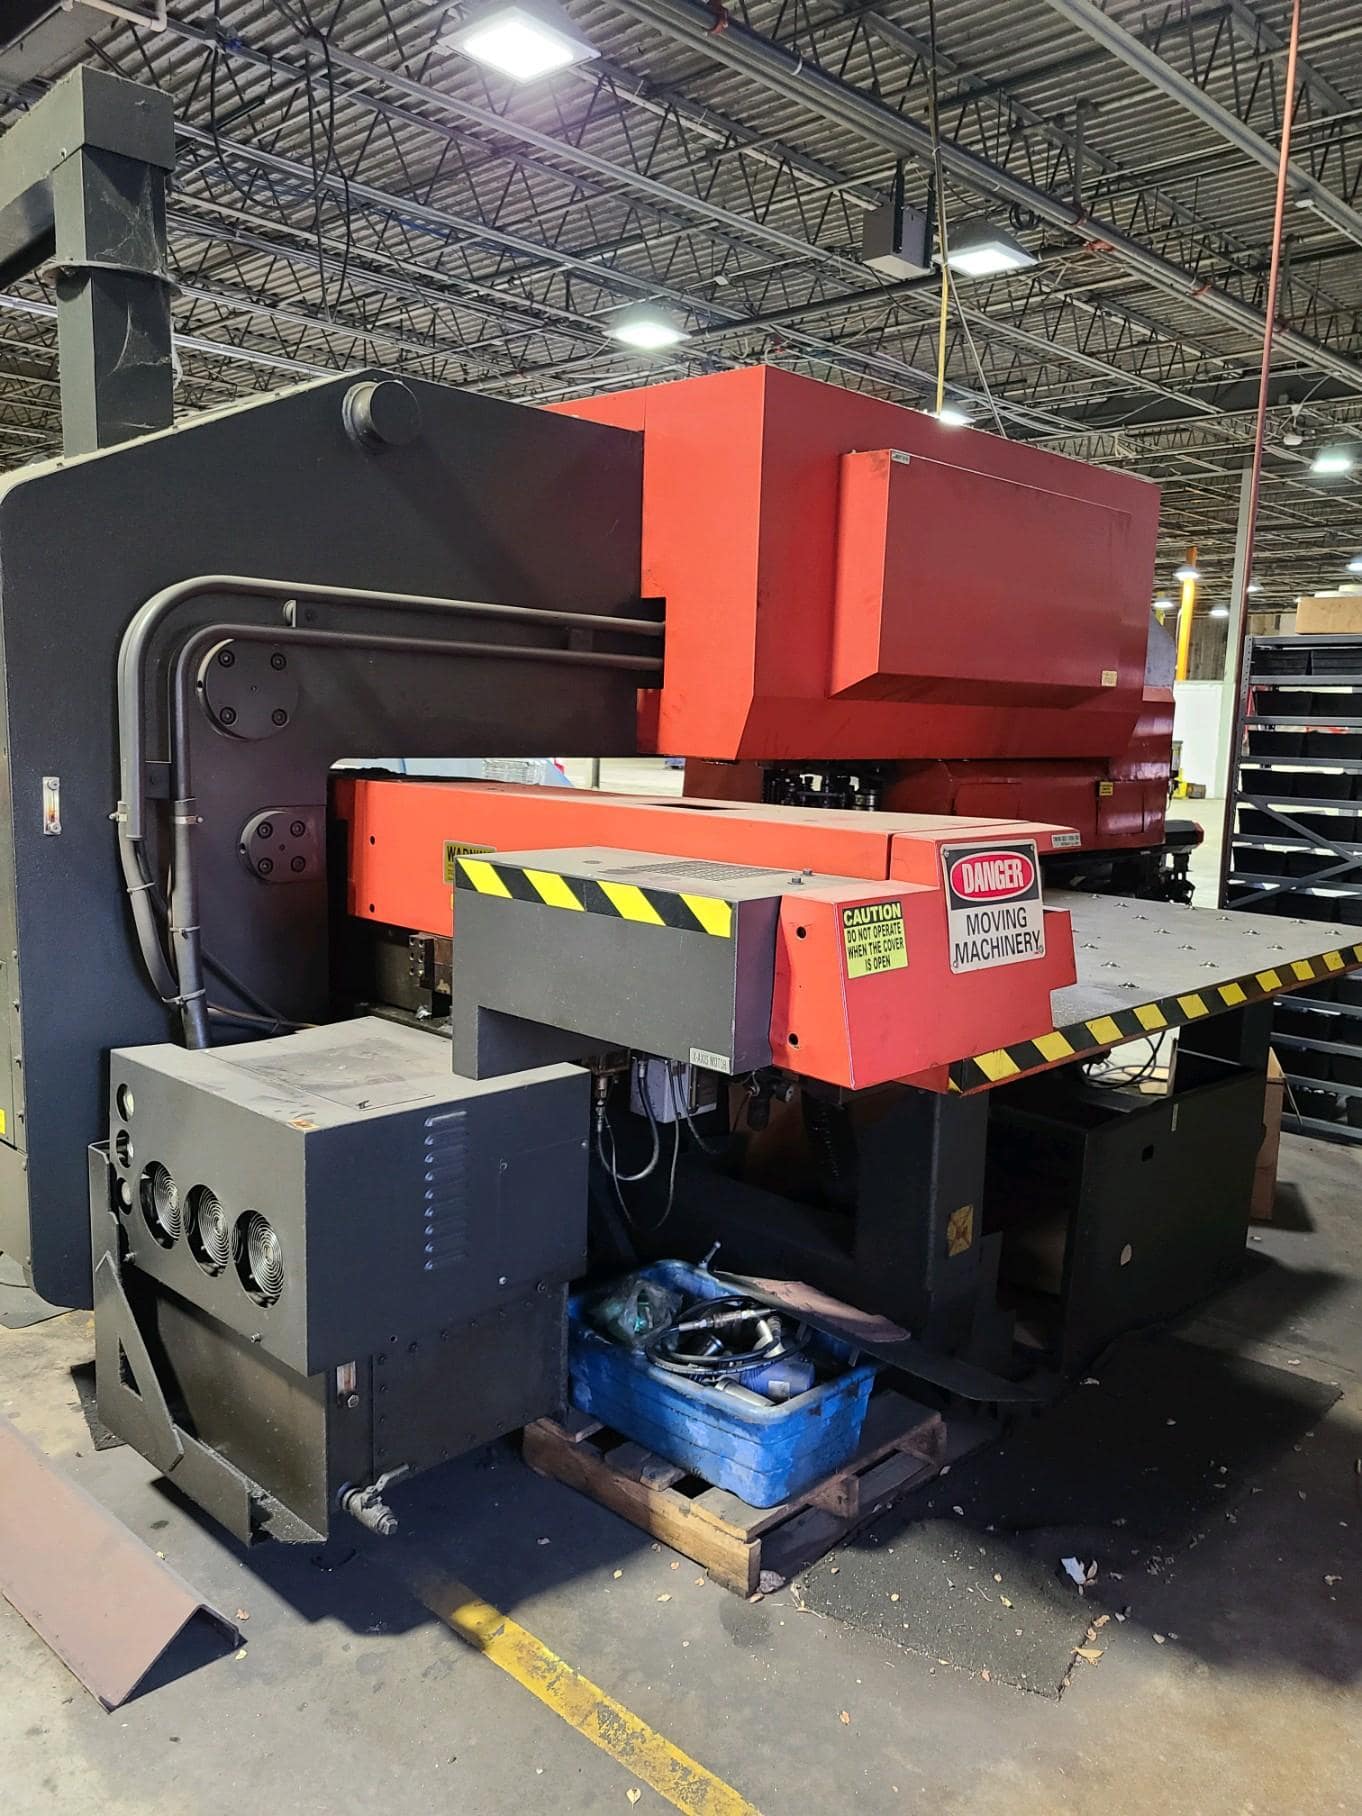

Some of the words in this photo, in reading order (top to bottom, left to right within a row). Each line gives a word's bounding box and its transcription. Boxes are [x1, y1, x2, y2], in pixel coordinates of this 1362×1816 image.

[962, 858, 1024, 894] DANGER
[843, 902, 902, 926] CAUTION
[966, 907, 1027, 936] MOVING
[847, 929, 857, 943] DO
[858, 926, 871, 941] NOT
[873, 921, 902, 938] OPERATE
[848, 943, 868, 960] WHEN
[868, 940, 882, 955] THE
[883, 937, 904, 953] COVER
[955, 930, 1040, 964] MACHINERY
[865, 958, 872, 972] IS
[873, 955, 891, 970] OPEN
